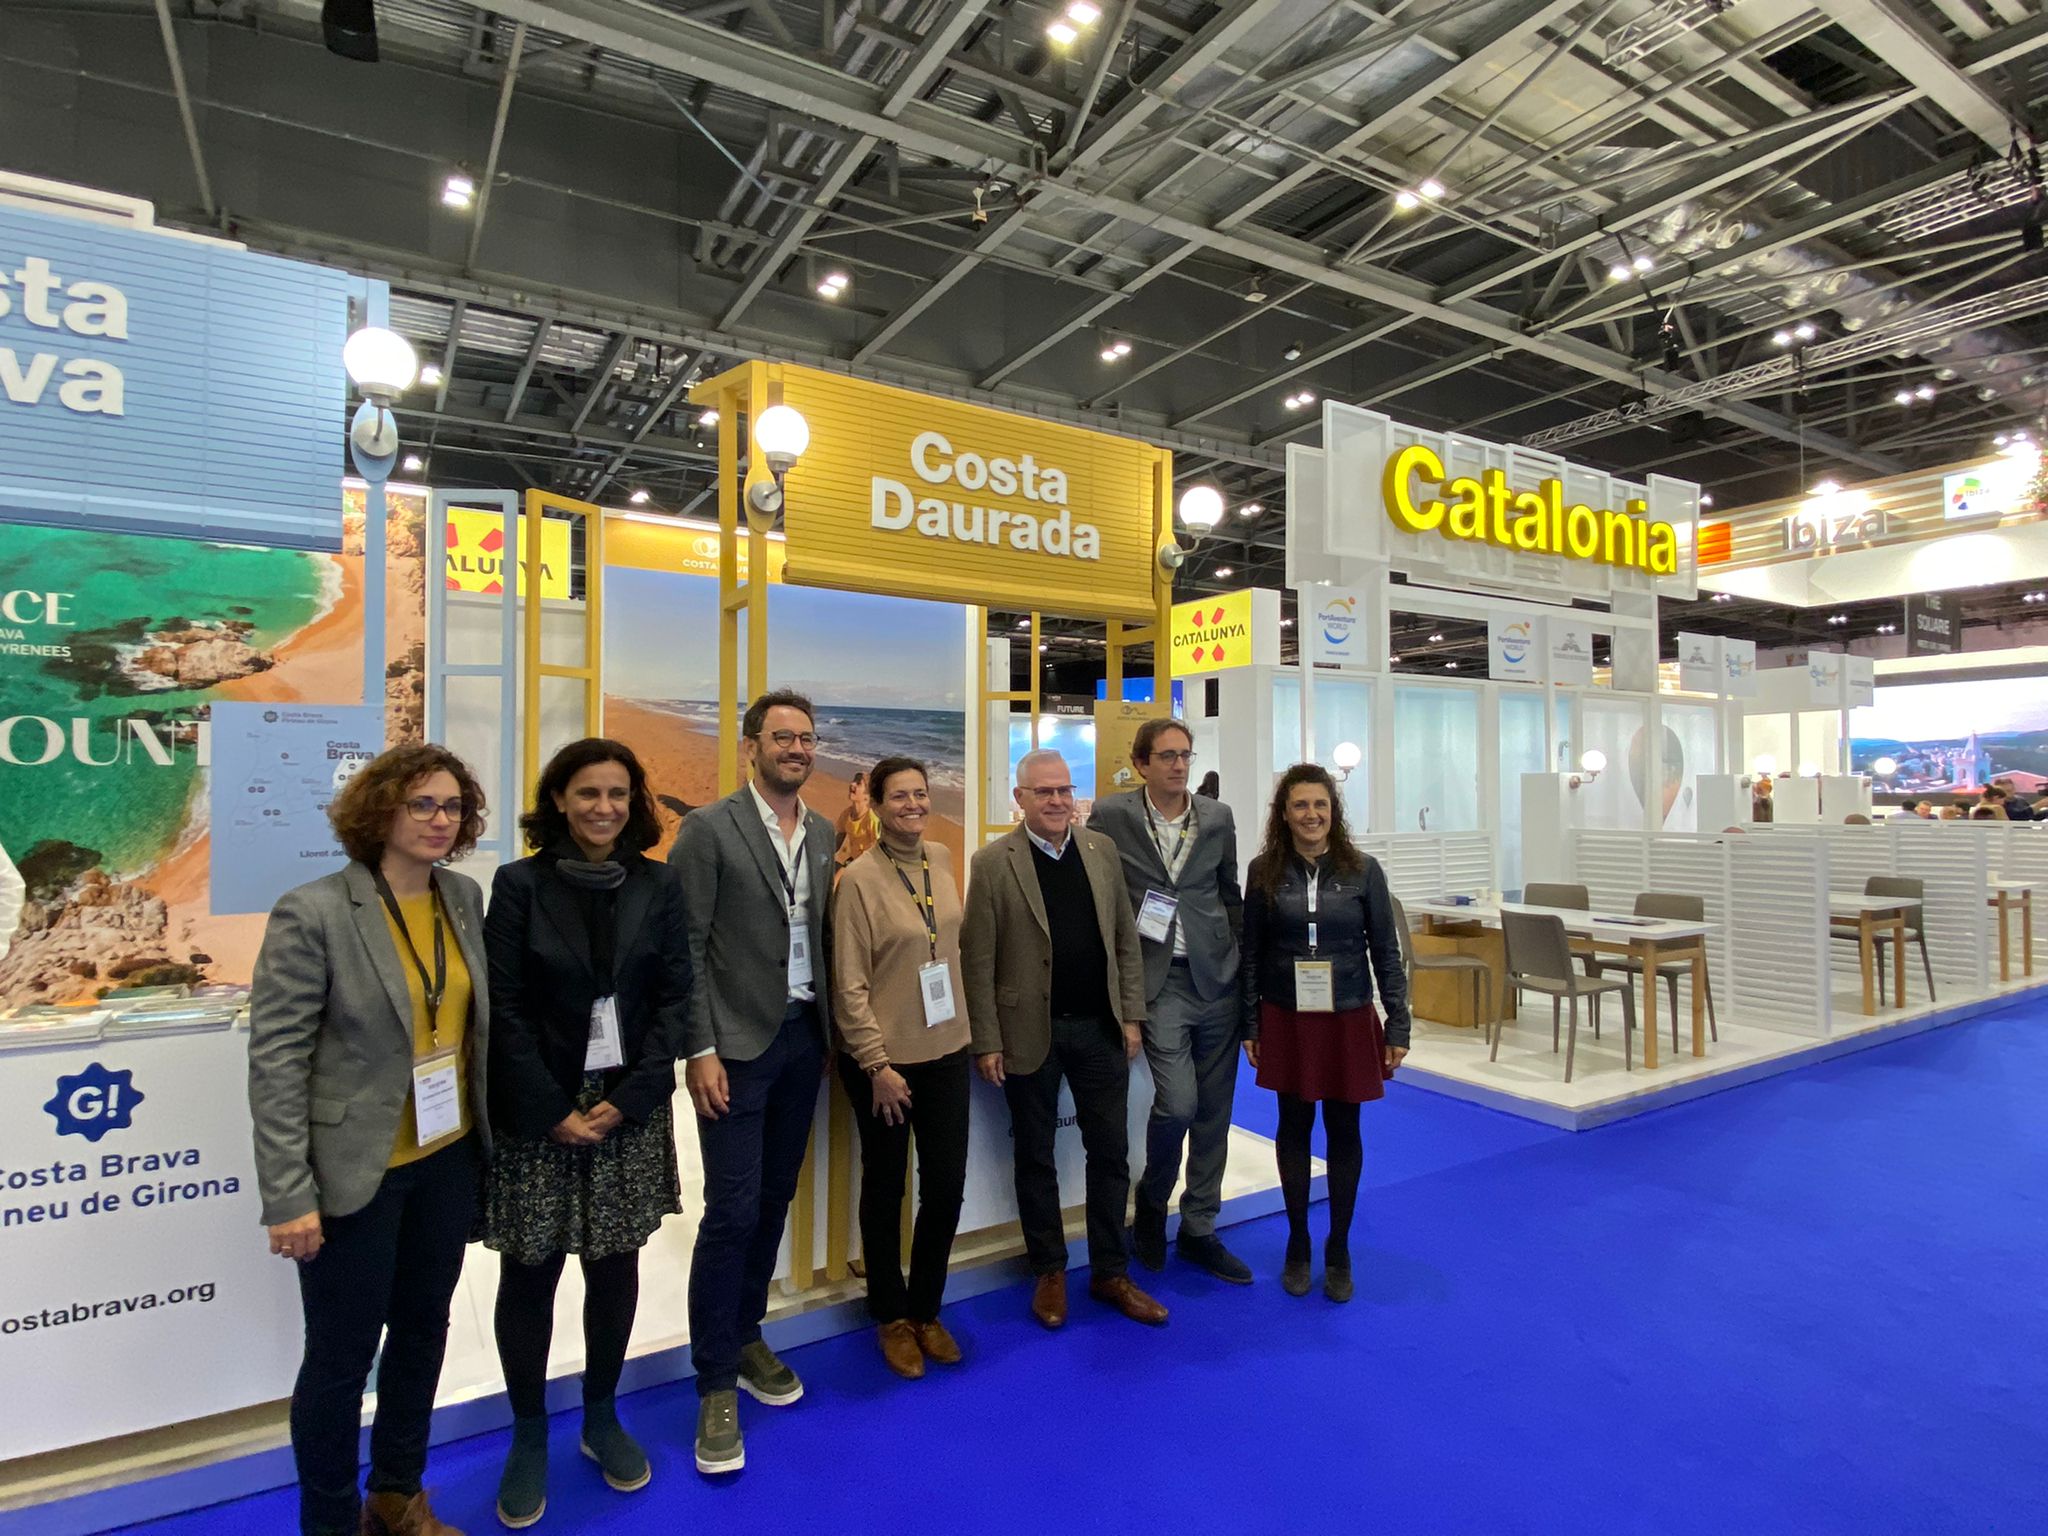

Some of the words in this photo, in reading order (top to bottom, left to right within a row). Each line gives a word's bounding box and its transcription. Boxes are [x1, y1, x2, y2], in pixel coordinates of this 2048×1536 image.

[910, 431, 1069, 505] Costa
[871, 476, 1100, 561] Daurada
[1383, 444, 1677, 575] Catalonia
[682, 559, 719, 570] COSTA
[1173, 623, 1245, 647] CATALUNYA
[1917, 613, 1951, 635] SQUARE
[1057, 705, 1085, 714] FUTURE
[326, 740, 360, 749] Costa
[326, 748, 375, 760] Brava
[101, 1147, 200, 1178] Brava
[81, 1191, 120, 1215] de
[132, 1176, 240, 1206] Girona
